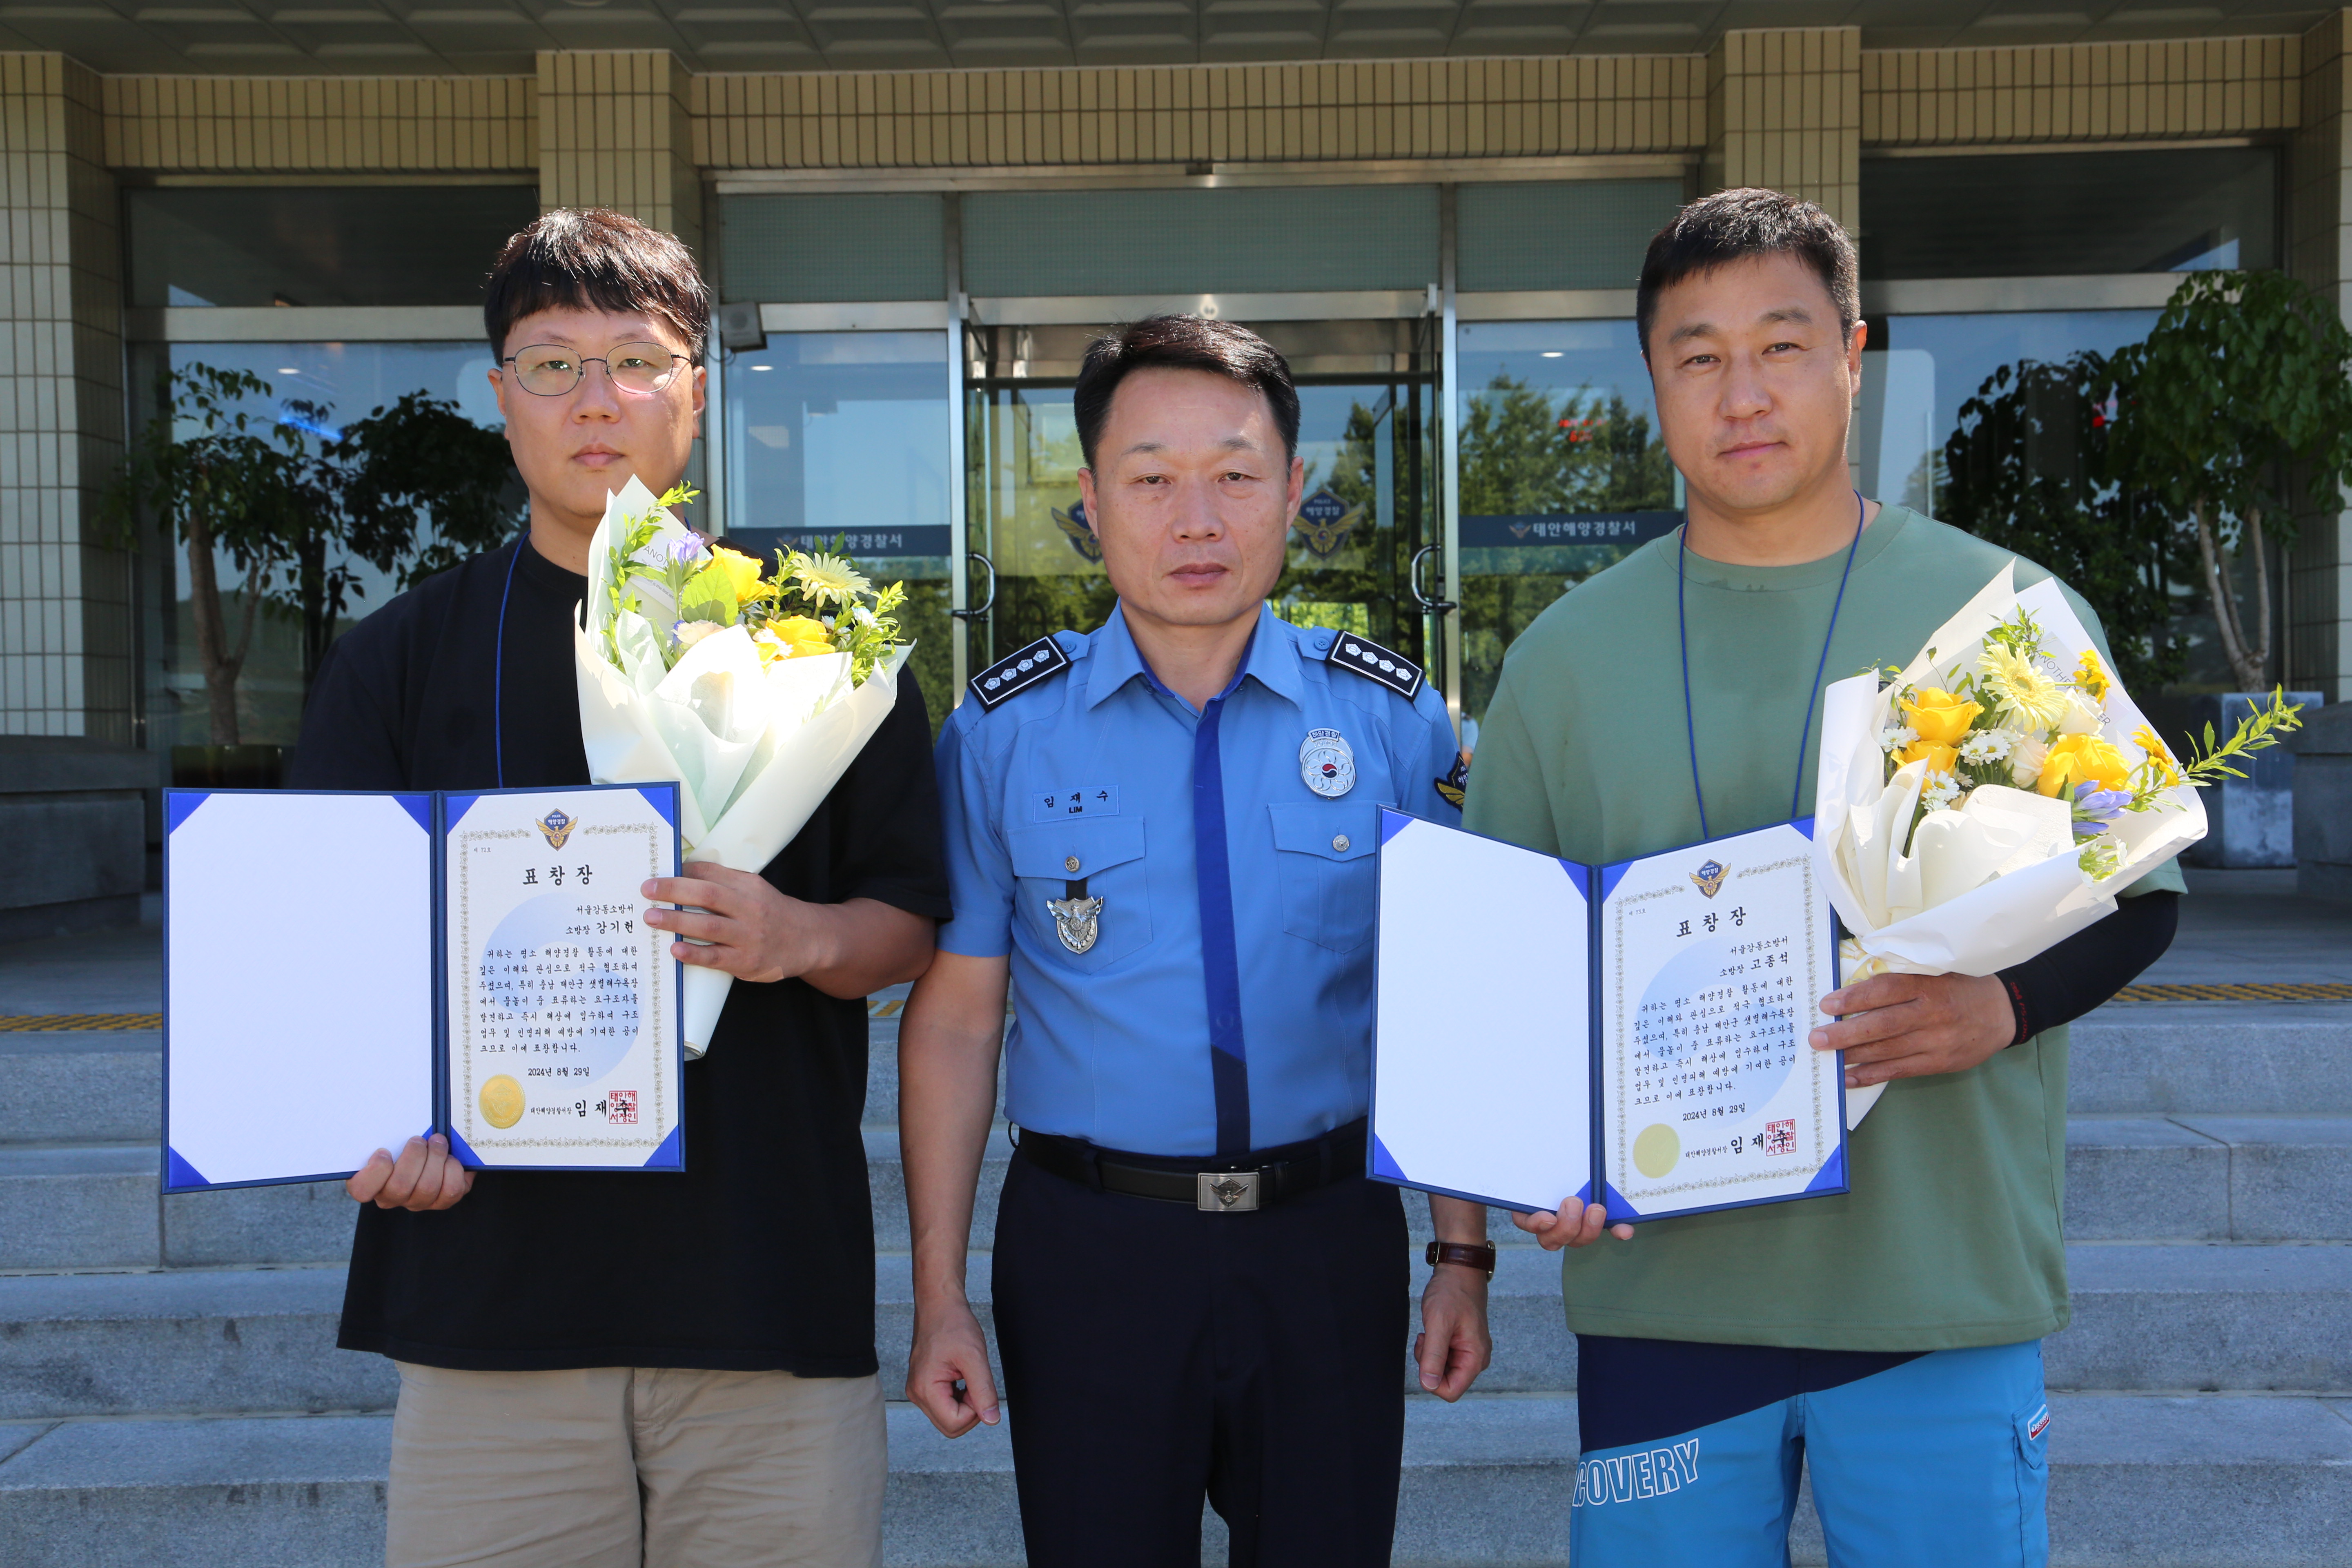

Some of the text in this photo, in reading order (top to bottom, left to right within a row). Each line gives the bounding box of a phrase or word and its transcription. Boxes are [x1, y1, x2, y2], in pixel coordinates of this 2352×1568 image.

[1533, 520, 1635, 537] 태안해양경찰서
[576, 904, 633, 915] 서울강동소방서
[565, 925, 590, 935] 소방장
[486, 949, 513, 960] 귀하는
[545, 947, 579, 958] 해양경찰
[588, 946, 612, 958] 활동에
[621, 945, 638, 956] 대한
[1730, 935, 1788, 956] 서울강동소방서
[479, 964, 495, 976] 깊은
[503, 964, 529, 975] 이해와
[535, 963, 571, 975] 관심으로
[579, 962, 596, 973] 적극
[1719, 964, 1744, 977] 소방장
[479, 980, 514, 991] 주셨으며,
[518, 979, 533, 990] 특히
[539, 979, 555, 991] 충남
[560, 978, 584, 990] 태안군
[480, 993, 638, 1007] 에서 물놀이 중 표류하는 요구조자를
[1641, 1002, 1667, 1014] 귀하는
[1699, 987, 1733, 1003] 해양경찰
[1742, 980, 1767, 995] 활동에
[1776, 976, 1793, 988] 대한
[480, 1010, 639, 1023] 발견하고 즉시 해상에 입수하여 구조
[1634, 1019, 1650, 1031] 깊은
[1658, 1012, 1683, 1026] 이해와
[1690, 1005, 1725, 1020] 관심으로
[1733, 1000, 1751, 1011] 적극
[480, 1025, 638, 1039] 업무 및 인명피해 예방에 기여한 공이
[1633, 1031, 1668, 1046] 주셨으며,
[1672, 1026, 1688, 1038] 특히
[1693, 1022, 1709, 1035] 충남
[1714, 1017, 1739, 1031] 태안군
[480, 1042, 580, 1054] 크므로 이에 표창합니다.
[1634, 1022, 1795, 1061] 에서 물놀이 중 표류하는 요구조자를
[1634, 1039, 1796, 1076] 발견하고 즉시 해상에 입수하여 구조
[528, 1067, 589, 1077] 2024년 8월 29일
[1635, 1054, 1795, 1092] 업무 및 인명피해 예방에 기여한 공이
[1634, 1080, 1736, 1105] 크므로 이에 표창합니다.
[530, 1106, 572, 1116] 태안해양경찰서장
[1683, 1102, 1745, 1121] 2024년 8월 29일
[1685, 1145, 1728, 1159] 태안해양경찰서장
